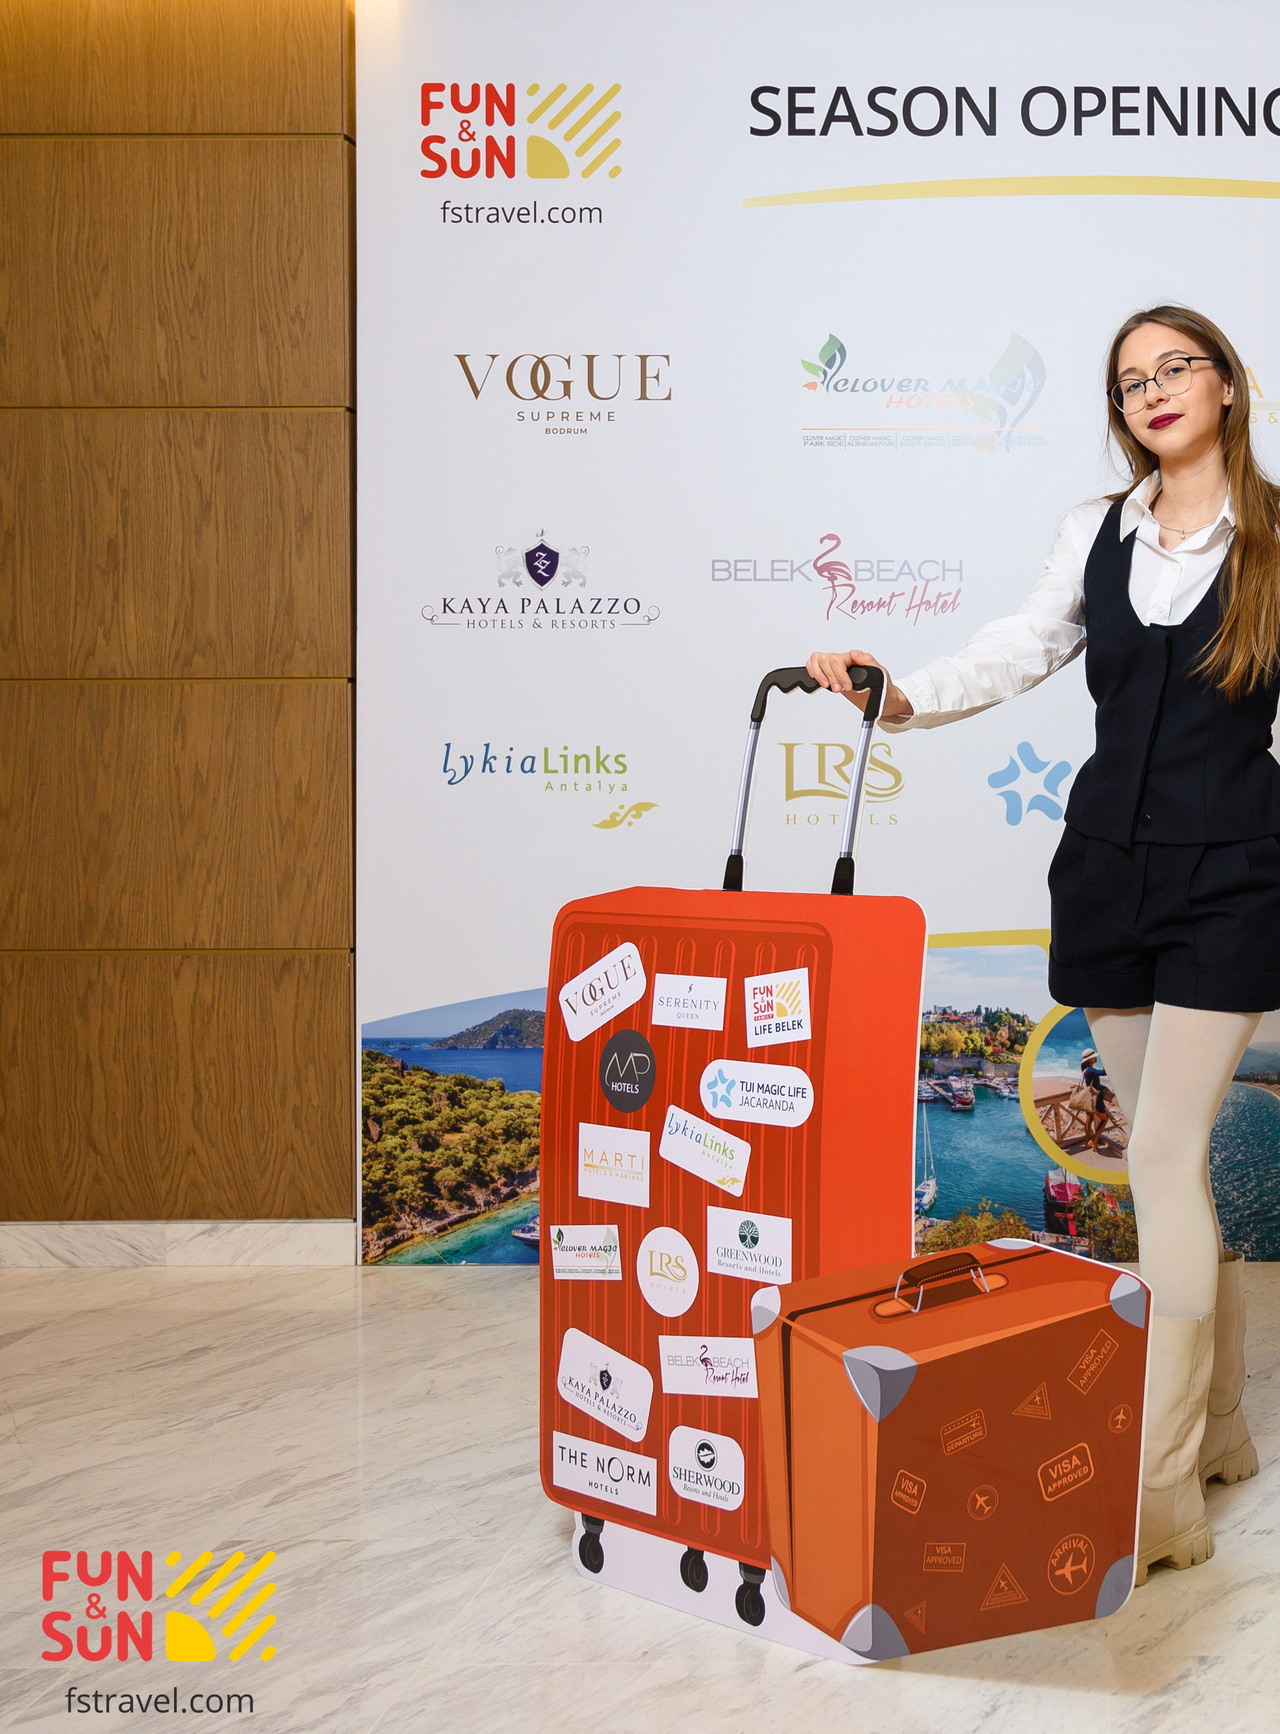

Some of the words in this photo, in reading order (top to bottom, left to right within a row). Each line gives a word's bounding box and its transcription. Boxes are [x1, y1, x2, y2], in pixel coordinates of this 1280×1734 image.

[421, 82, 516, 127] FUN
[749, 86, 997, 137] SEASON
[458, 120, 477, 142] &
[421, 135, 516, 179] SUN
[441, 201, 603, 224] fstravel.com
[454, 353, 672, 402] VOGUE
[833, 377, 930, 393] CLOVER
[940, 377, 1042, 394] MAGIC
[886, 394, 976, 409] HOTELS
[517, 411, 616, 422] SUPREME
[1268, 413, 1278, 424] &
[545, 427, 588, 435] BODRUM
[712, 560, 812, 582] BELEK
[855, 560, 963, 582] BEACH
[441, 596, 515, 615] KAYA
[520, 595, 642, 615] PALAZZO
[826, 581, 899, 621] Resort
[905, 581, 962, 627] Hotel
[466, 619, 528, 629] HOTELS
[532, 618, 543, 629] &
[550, 619, 616, 629] RESORTS
[777, 742, 906, 802] LRS
[544, 780, 629, 793] Antalya
[786, 814, 898, 826] HOTLS
[564, 954, 637, 1016] VOGUE
[753, 985, 773, 1000] FUN
[589, 991, 622, 1017] SUPREME
[658, 996, 720, 1011] SERENITY
[753, 1000, 774, 1015] SUN
[676, 1012, 700, 1020] QUEEN
[754, 1023, 773, 1036] LIFE
[775, 1019, 804, 1033] BELEK
[605, 1052, 650, 1087] MP
[611, 1081, 639, 1094] HOTELS
[739, 1080, 755, 1093] TUI
[756, 1082, 786, 1097] MAGIC
[788, 1085, 807, 1099] LIFE
[738, 1095, 795, 1112] JACARANDA
[583, 1147, 645, 1171] MARTI
[583, 1167, 608, 1177] HOTELS
[614, 1171, 645, 1182] MARINAS
[589, 1245, 617, 1253] MAGIC
[716, 1246, 783, 1268] GREENWOOD
[648, 1250, 688, 1283] LRS
[717, 1259, 743, 1271] Resorts
[744, 1265, 757, 1273] and
[758, 1265, 782, 1277] Hotels
[649, 1282, 686, 1294] HOTELS
[668, 1355, 700, 1366] BELEK
[712, 1357, 749, 1369] BEACH
[1079, 1349, 1098, 1370] VISA
[1079, 1340, 1112, 1387] APPROVED
[568, 1376, 592, 1397] KAYA
[594, 1389, 637, 1424] PALAZZO
[575, 1391, 595, 1407] HOTELS
[603, 1407, 627, 1426] RESORTS
[946, 1430, 984, 1452] DEPARTURE
[558, 1445, 588, 1468] THE
[596, 1456, 651, 1487] NORM
[1049, 1454, 1081, 1478] VISA
[588, 1480, 619, 1496] HOTELS
[672, 1466, 741, 1496] SHERWOOD
[901, 1477, 918, 1496] VISA
[1047, 1466, 1089, 1494] APPROVED
[683, 1483, 700, 1494] Resorts
[701, 1488, 712, 1497] and
[713, 1490, 729, 1503] Hotels
[894, 1490, 918, 1508] APPROVED
[926, 1556, 962, 1564] APPROVED
[936, 1546, 951, 1554] VISA
[1050, 1538, 1089, 1567] ARRIVAL
